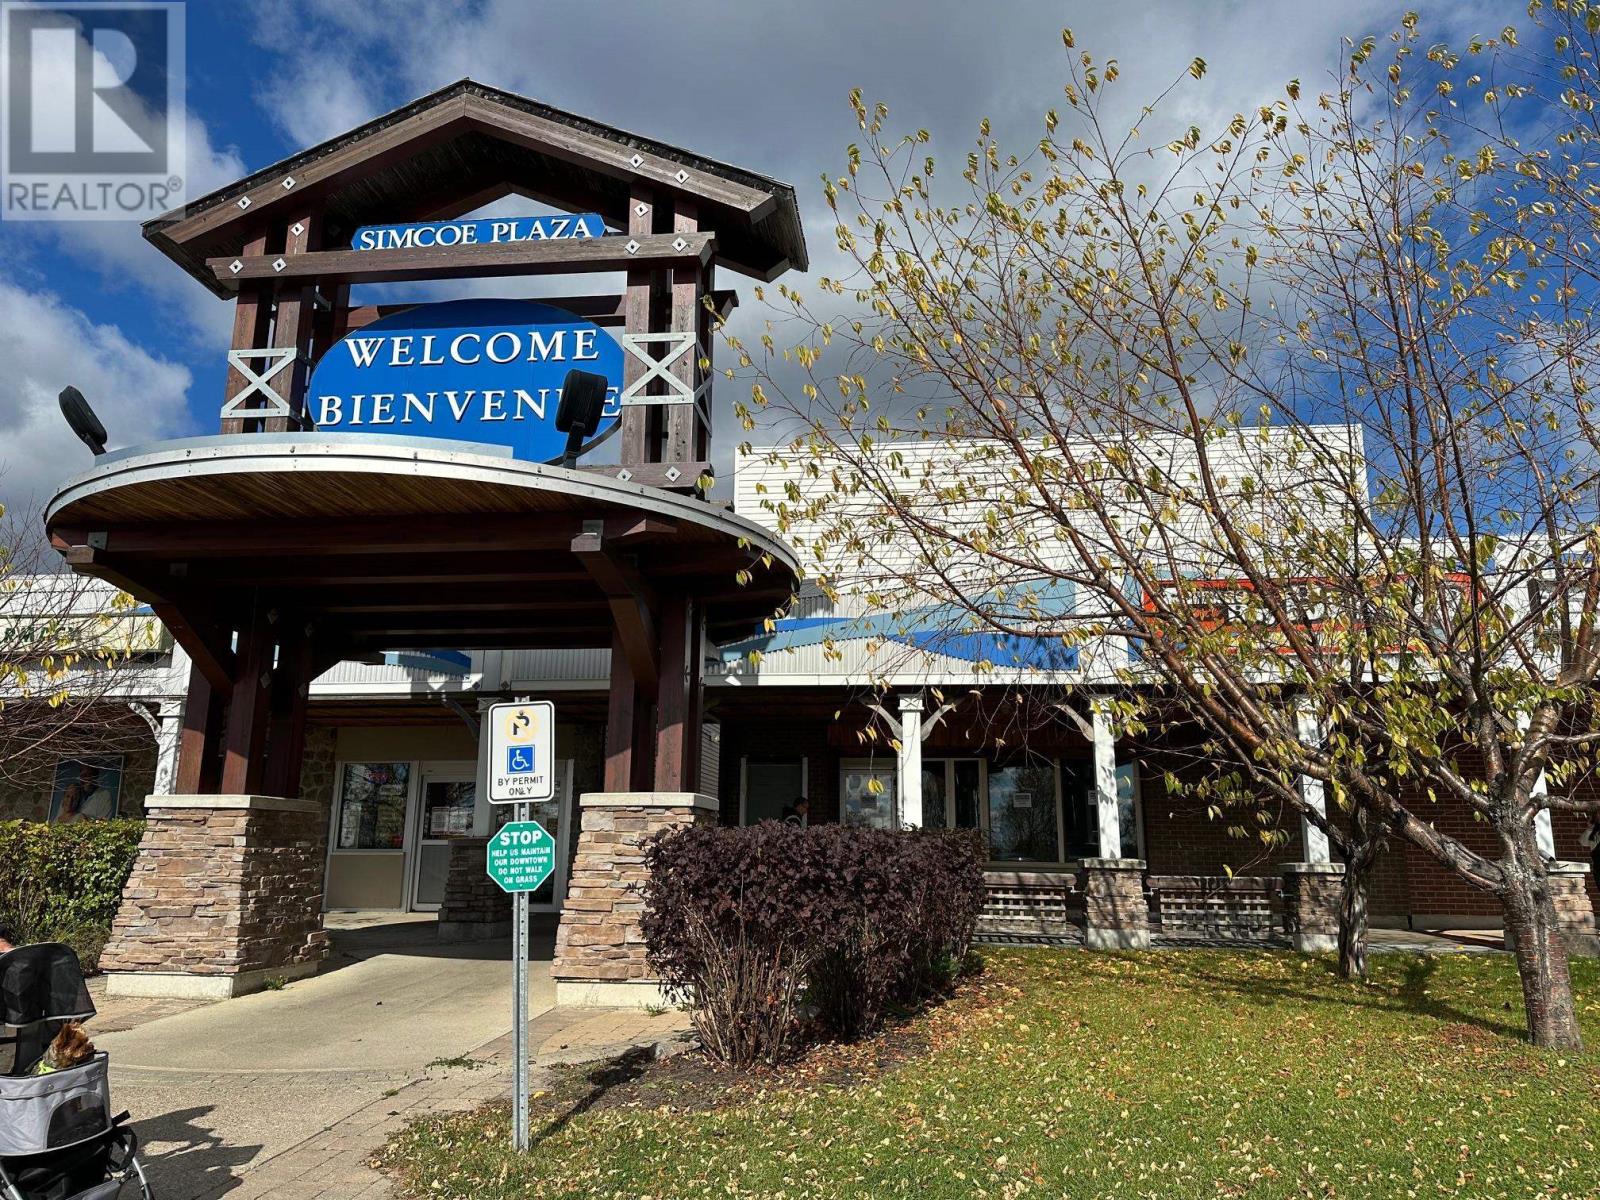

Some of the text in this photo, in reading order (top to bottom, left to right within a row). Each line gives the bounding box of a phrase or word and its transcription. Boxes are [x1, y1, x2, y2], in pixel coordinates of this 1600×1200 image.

[359, 218, 593, 250] SIMCOE PLAZA
[345, 329, 600, 368] WELCOME
[316, 386, 621, 427] BIENVENE
[497, 775, 544, 787] BY PERMIT
[508, 786, 533, 796] ONLY
[500, 830, 543, 846] STOP
[491, 846, 551, 857] HELP US MAINTAIN
[494, 856, 548, 866] OUR DOWNTOWN
[498, 867, 508, 875] DO
[525, 865, 543, 873] WALK
[503, 875, 538, 884] ON GRASS
